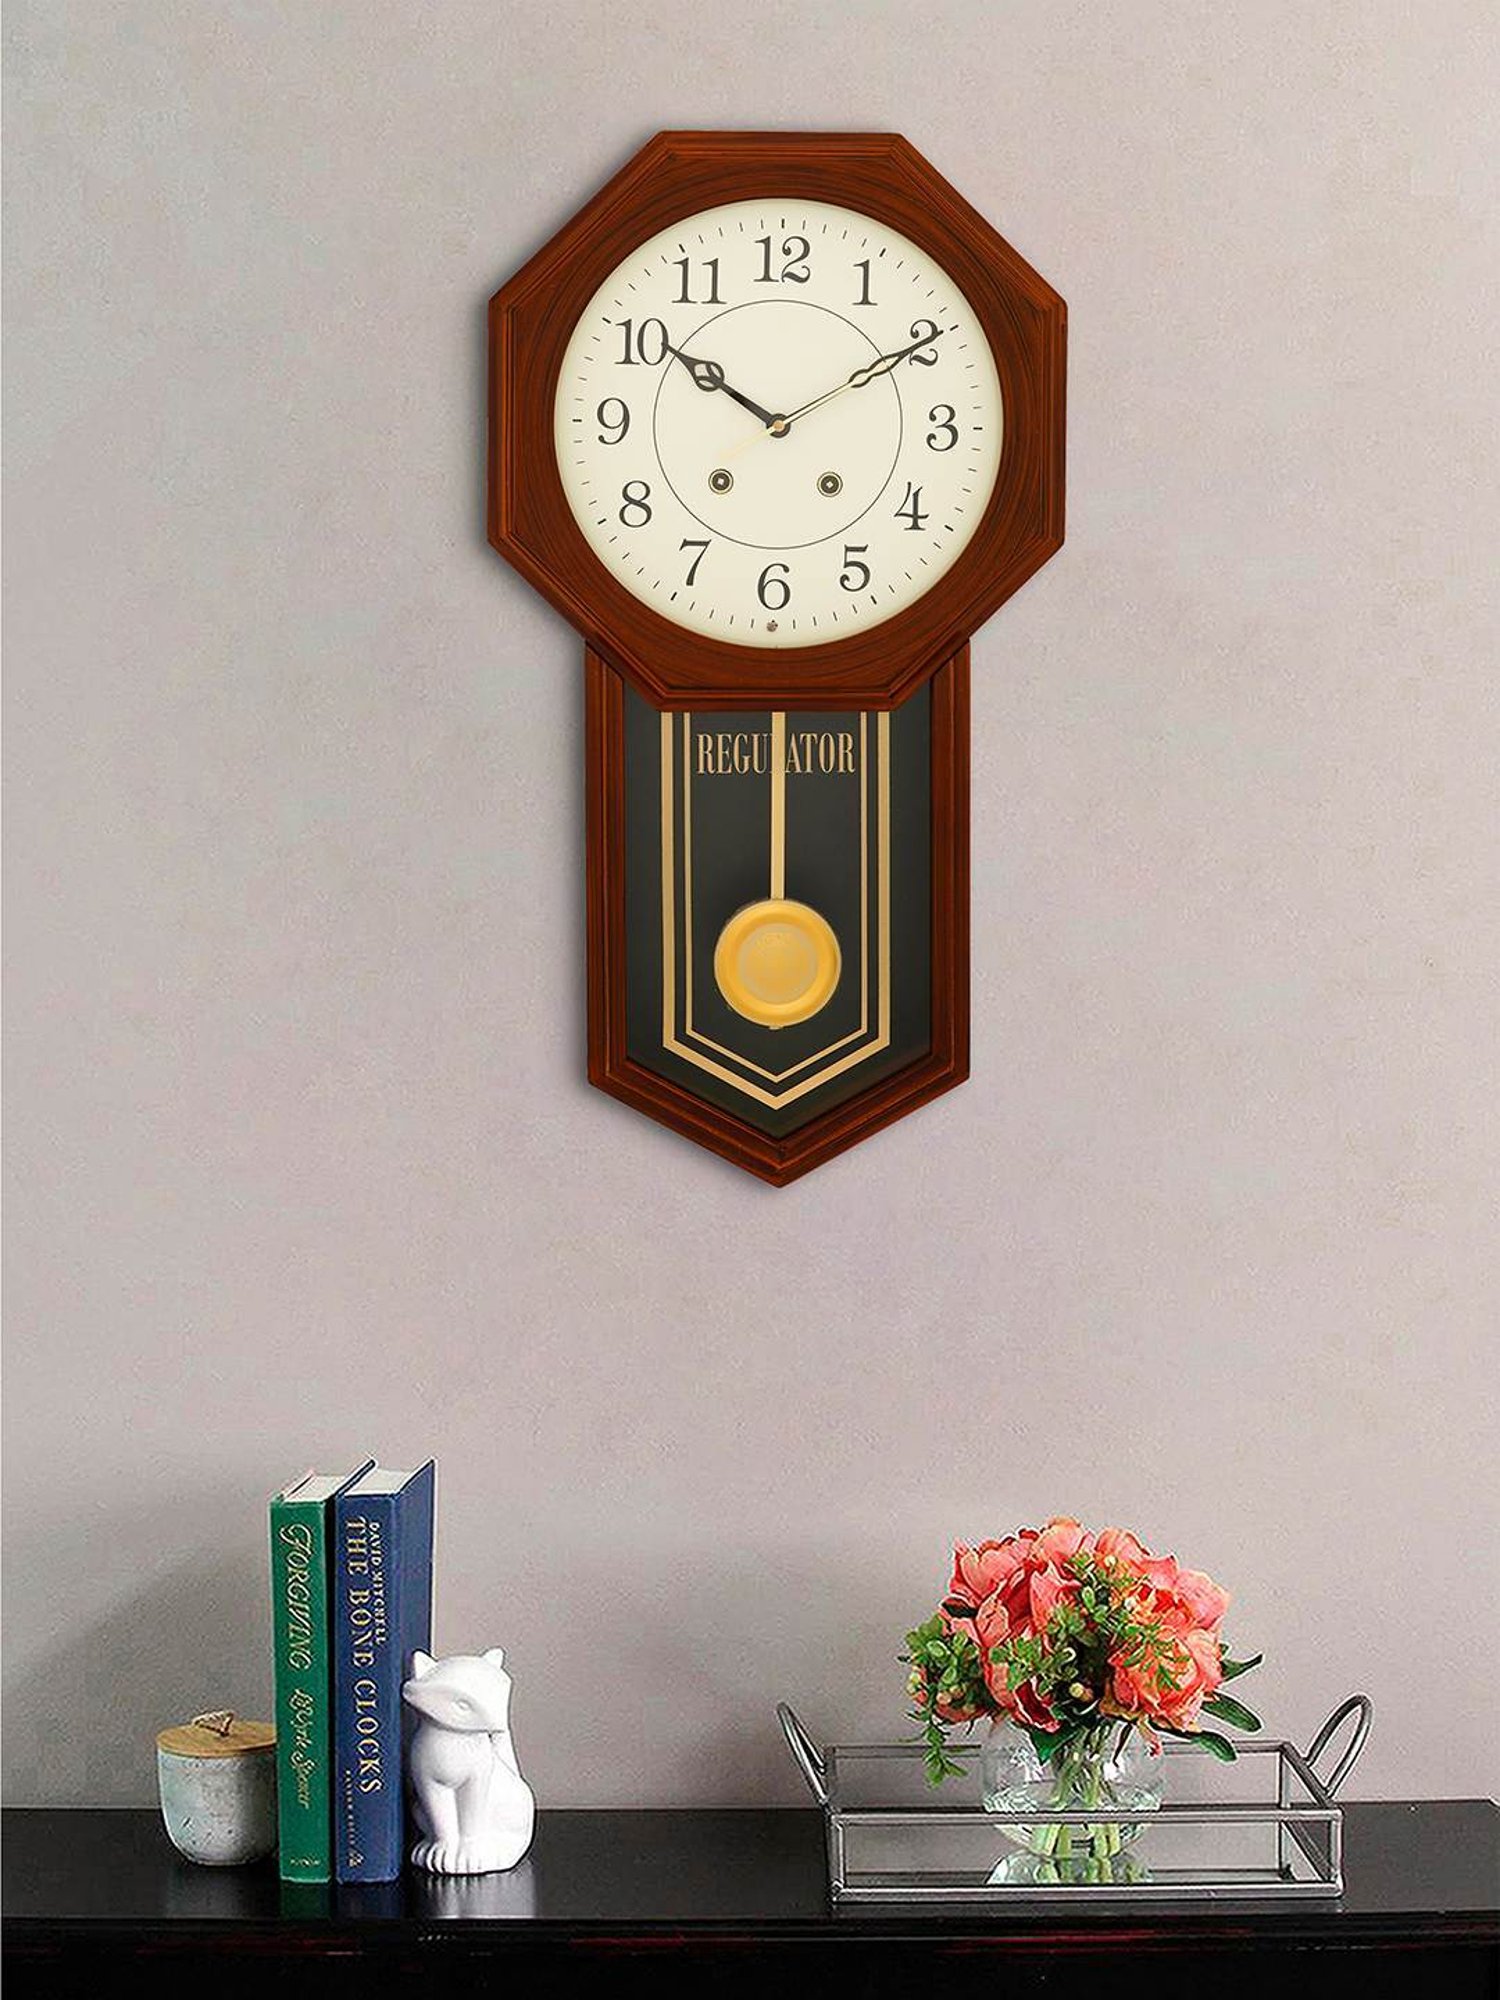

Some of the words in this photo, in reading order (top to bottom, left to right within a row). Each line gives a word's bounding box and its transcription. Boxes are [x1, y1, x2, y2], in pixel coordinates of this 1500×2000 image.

[671, 256, 727, 305] 11
[753, 235, 811, 284] 12
[852, 259, 878, 306] 1
[615, 317, 671, 367] 10
[906, 318, 939, 367] 2
[596, 397, 630, 445] 9
[926, 403, 959, 452] 3
[618, 480, 653, 528] 8
[893, 481, 930, 531] 4
[678, 538, 712, 587] 7
[757, 563, 791, 611] 6
[839, 544, 871, 593] 5
[696, 732, 856, 775] REGUATOR
[346, 1516, 369, 1577] THE
[369, 1522, 382, 1566] DAVID
[280, 1523, 312, 1671] FORGIVING
[349, 1589, 374, 1668] BONE
[354, 1680, 384, 1795] CLOCKS
